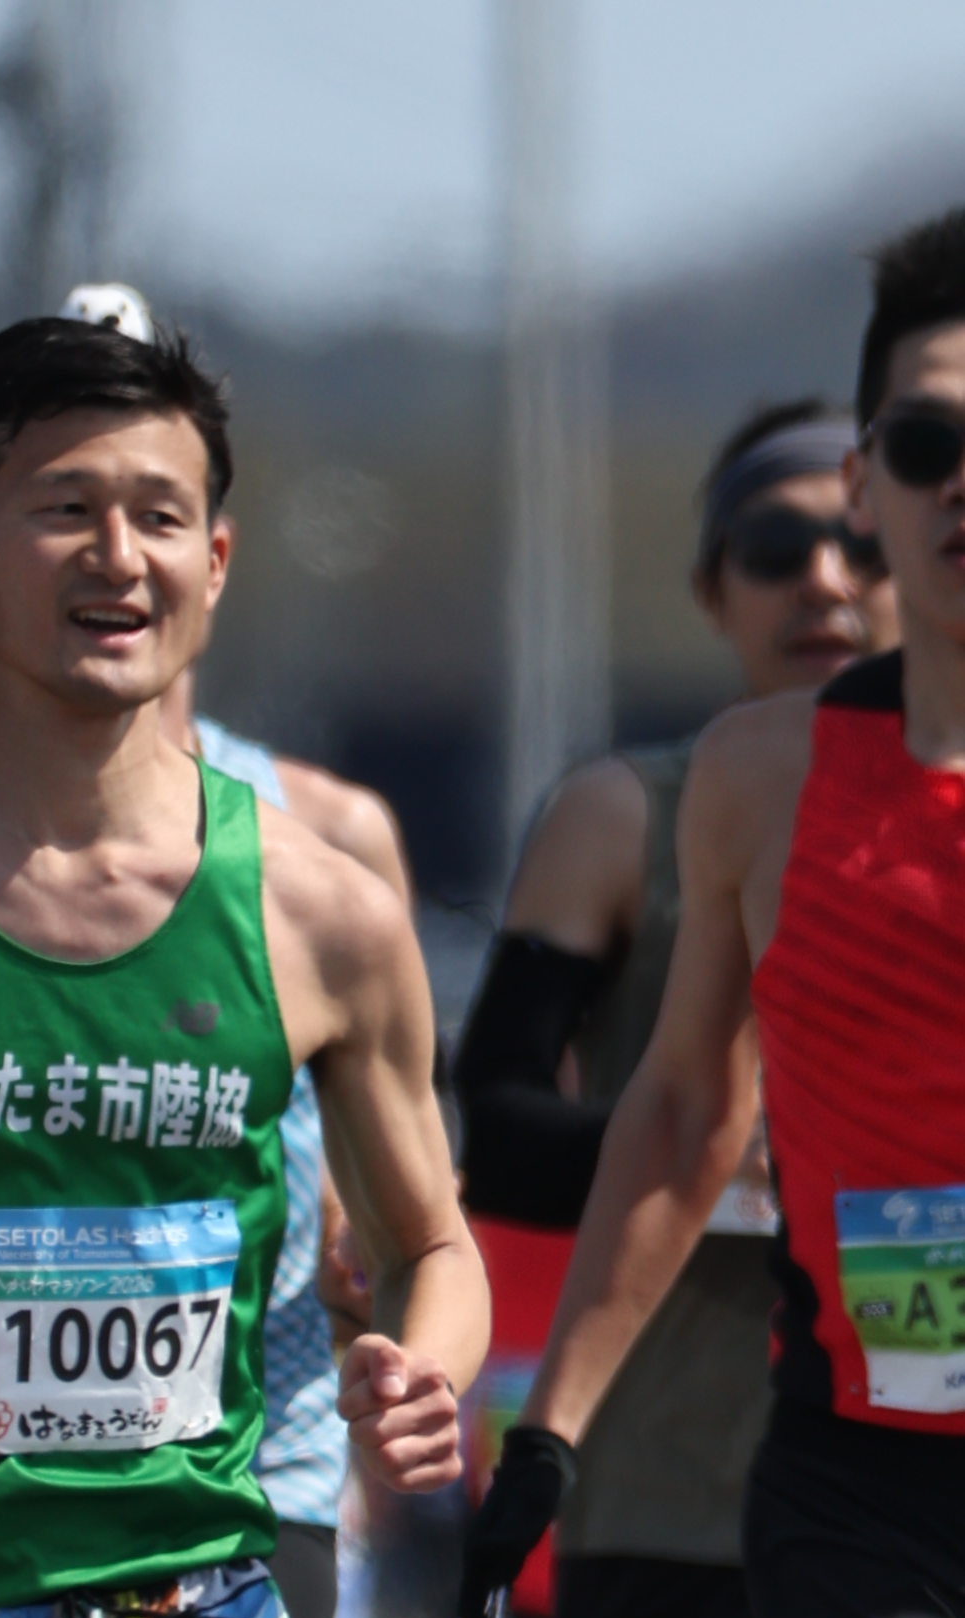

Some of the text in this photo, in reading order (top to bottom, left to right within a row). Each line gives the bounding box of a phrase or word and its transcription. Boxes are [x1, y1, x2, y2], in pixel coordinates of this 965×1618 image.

[18, 1404, 162, 1441] はなまるうどん
